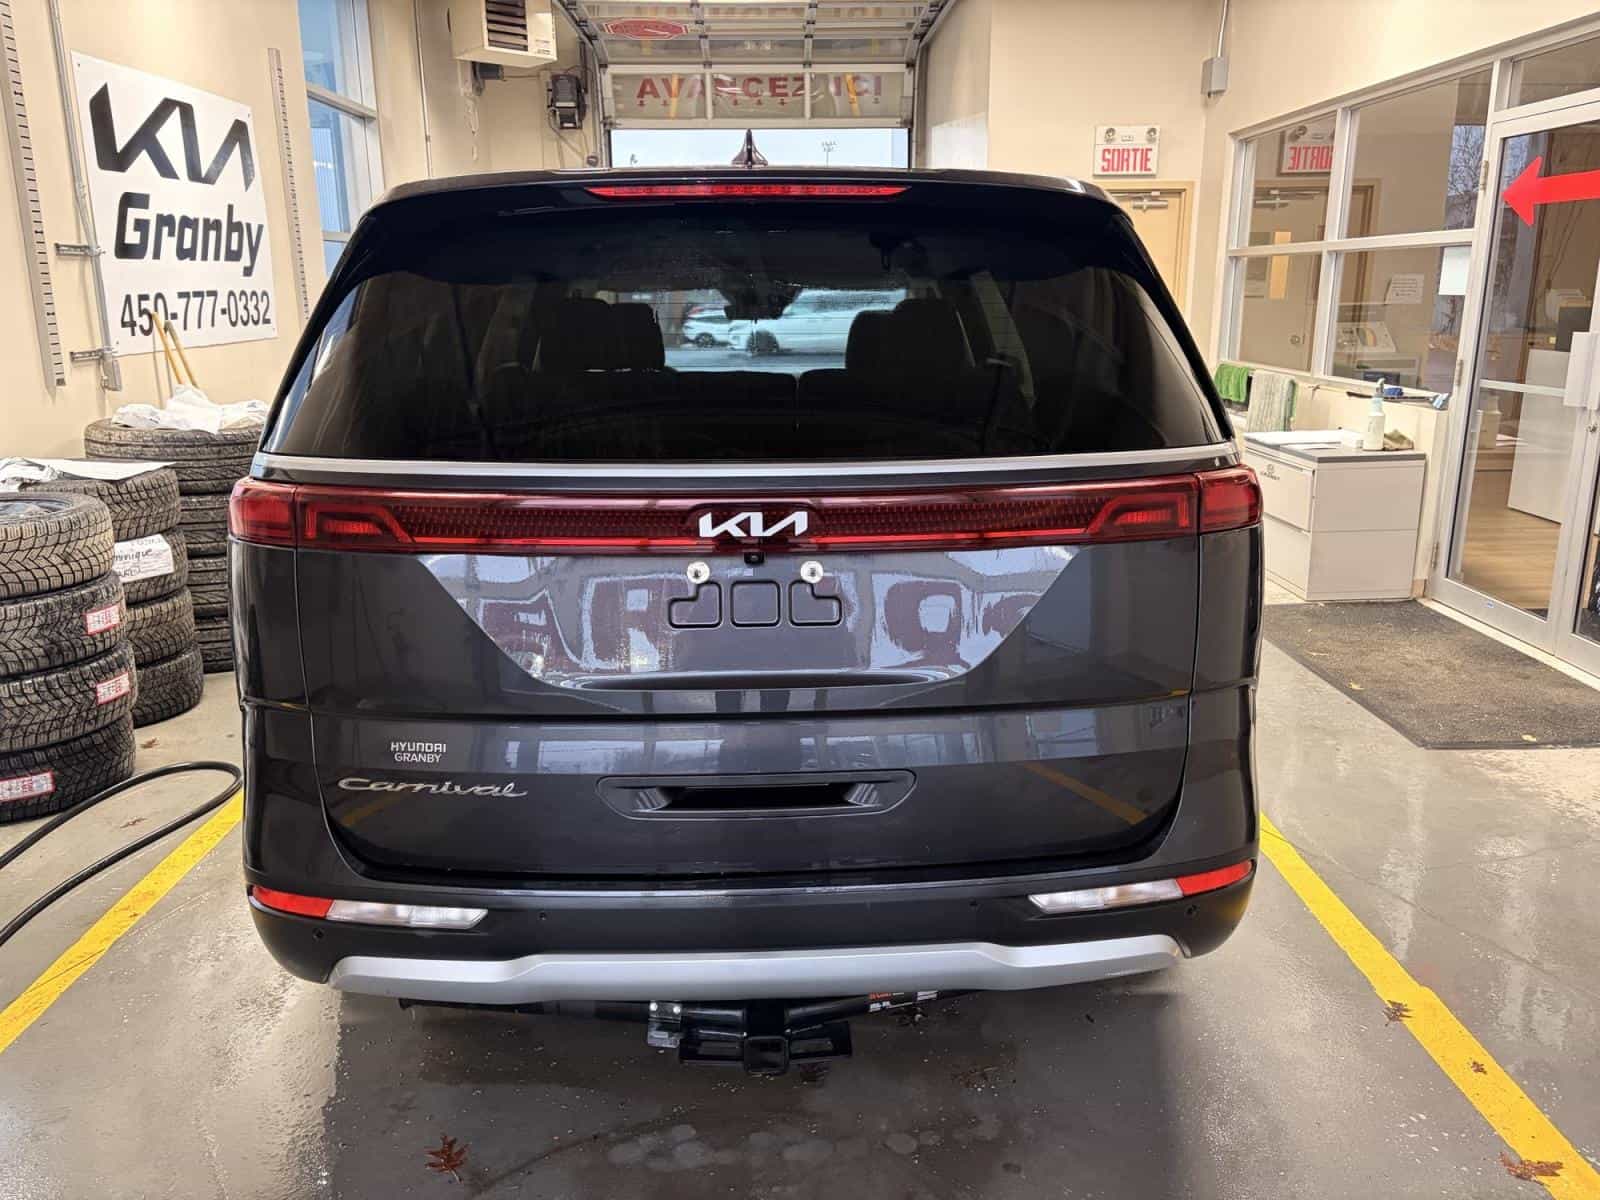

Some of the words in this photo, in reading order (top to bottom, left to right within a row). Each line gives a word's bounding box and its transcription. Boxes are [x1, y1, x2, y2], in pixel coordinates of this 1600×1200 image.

[89, 82, 255, 192] KIA
[1101, 147, 1153, 172] SORTIE
[114, 191, 264, 277] Granby
[120, 290, 271, 337] 450-777-0332
[699, 511, 808, 537] KIA
[390, 741, 447, 753] HYUNDAI
[394, 752, 442, 763] GRANBY
[338, 777, 528, 797] Carnival
